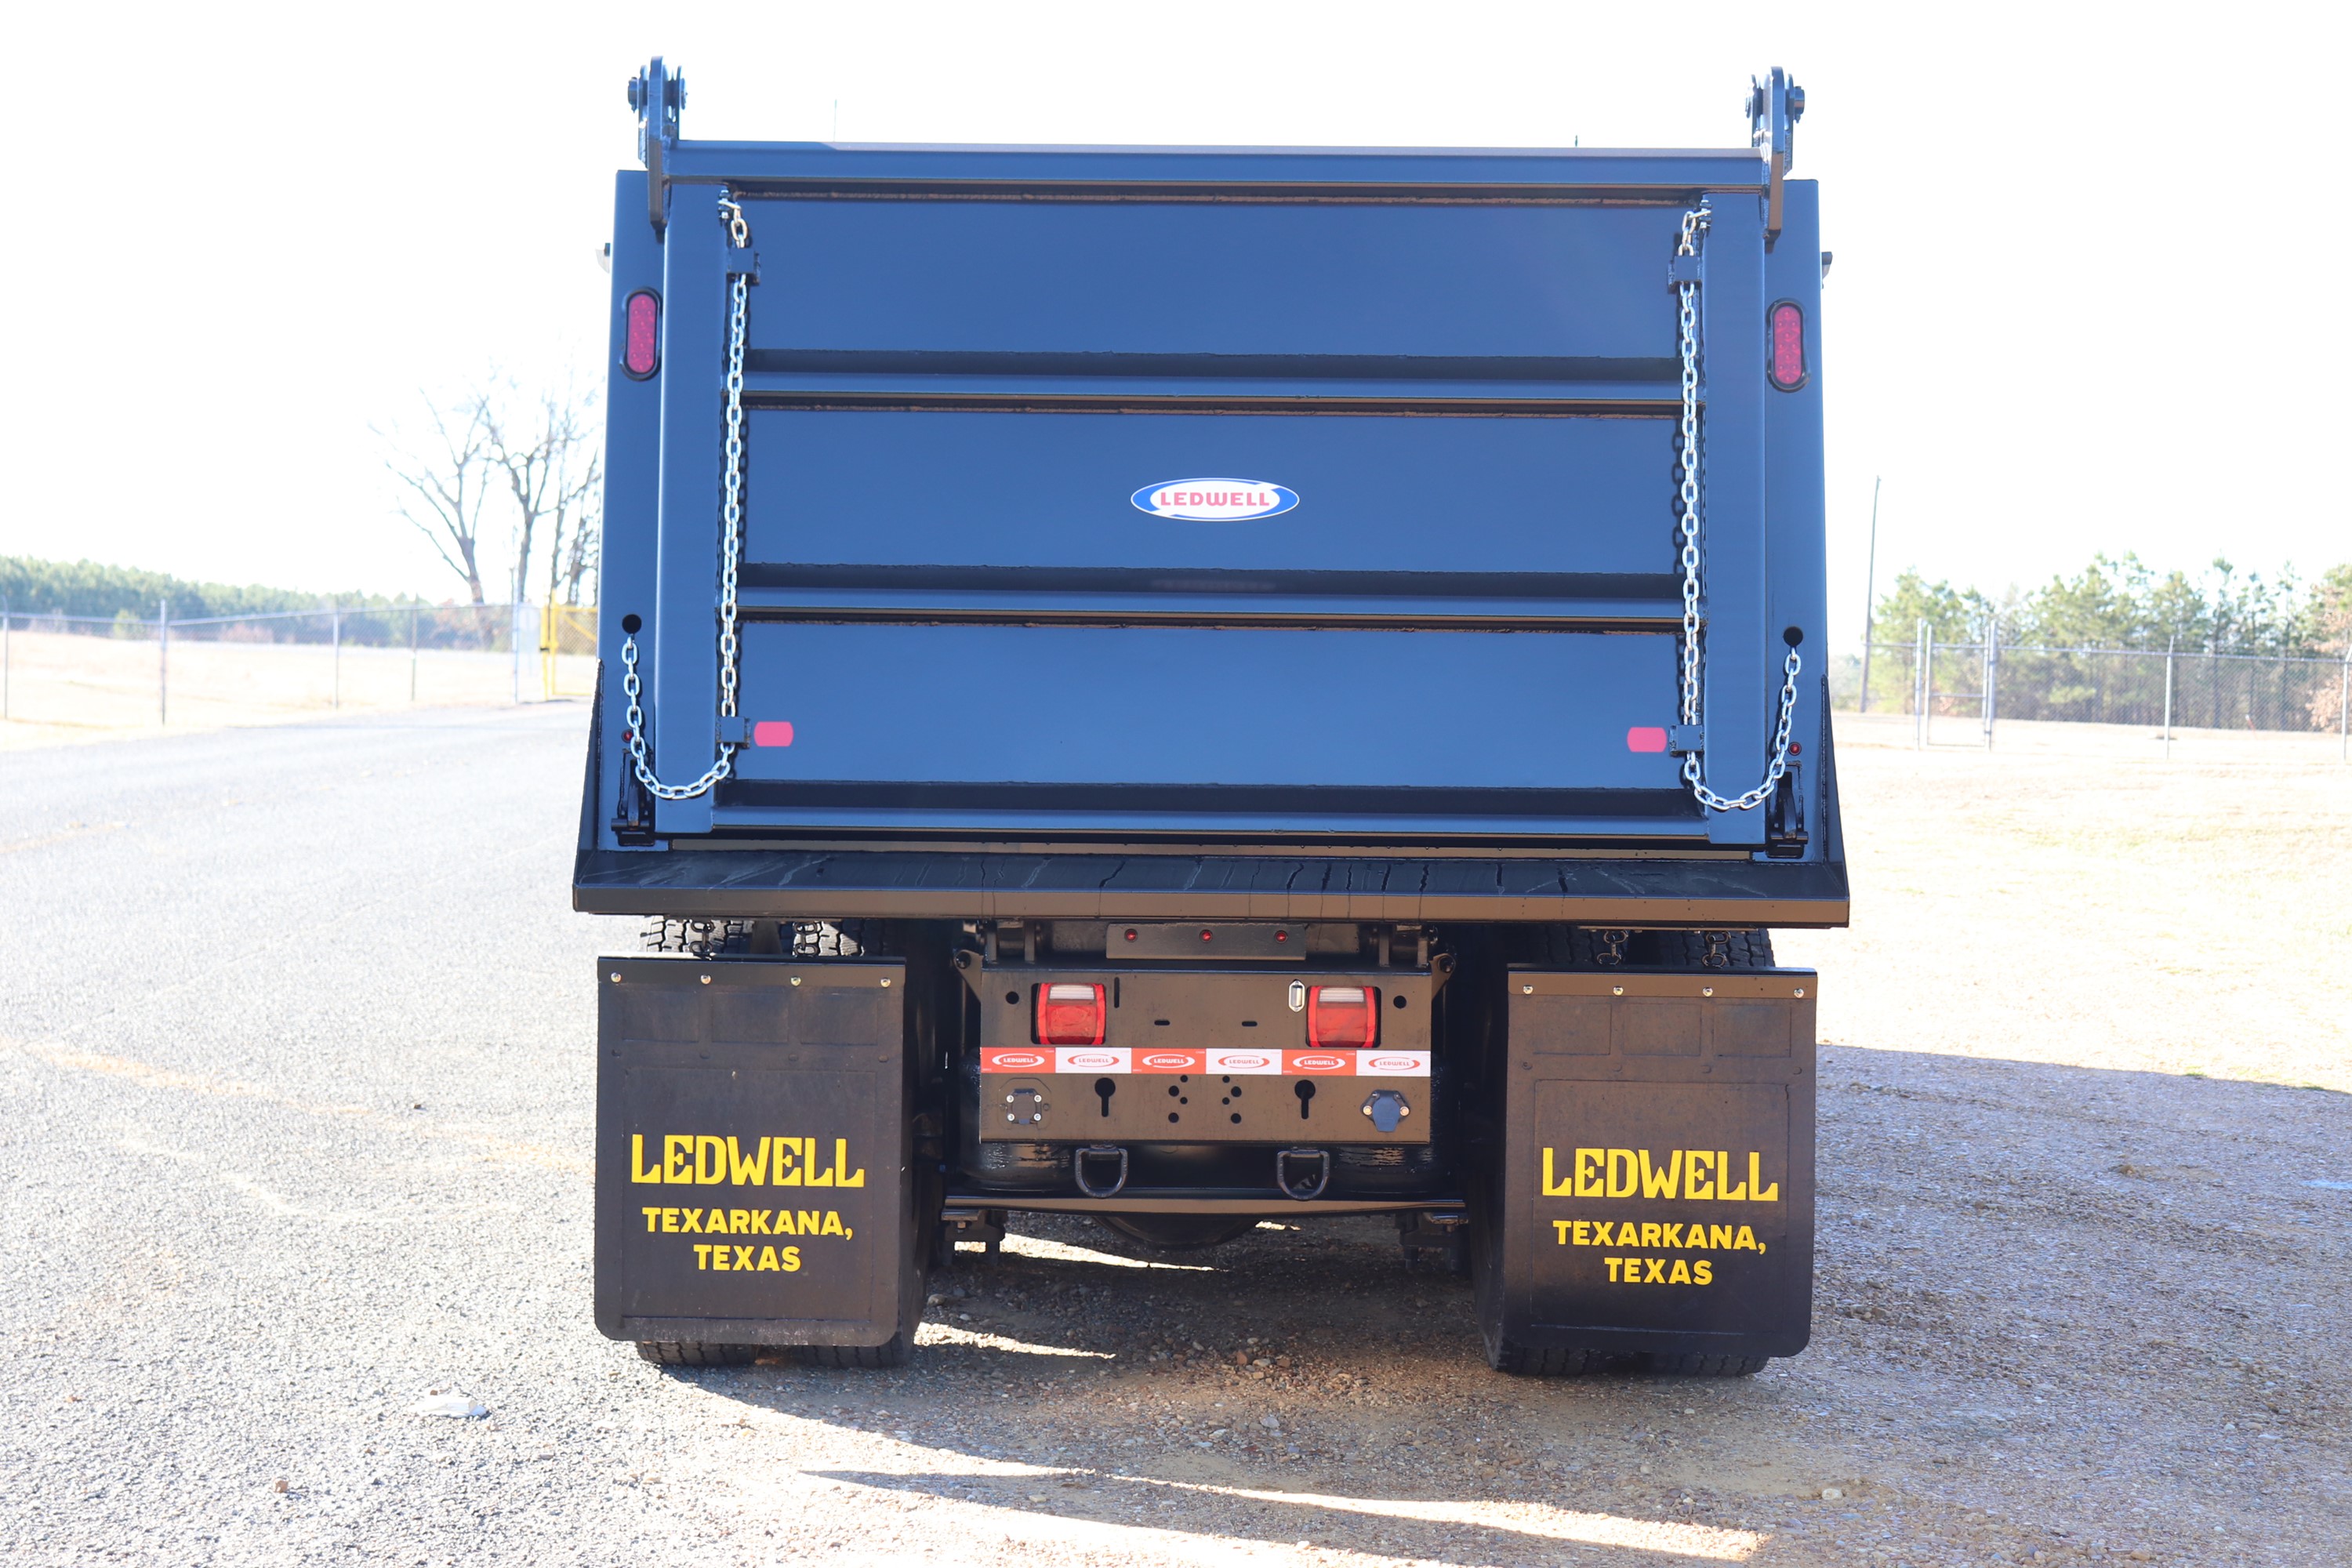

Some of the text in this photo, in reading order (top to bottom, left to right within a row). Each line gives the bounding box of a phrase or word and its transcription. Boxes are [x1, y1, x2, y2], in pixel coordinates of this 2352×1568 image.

[1160, 492, 1270, 506] LEDWELL
[631, 1134, 865, 1188] LEDWELL
[1542, 1147, 1778, 1201] LEDWELL
[642, 1207, 853, 1240] TEXARKANA,
[1552, 1220, 1766, 1255] TEXARKANA,
[693, 1244, 801, 1272] TEXAS
[1604, 1258, 1713, 1286] TEXAS
